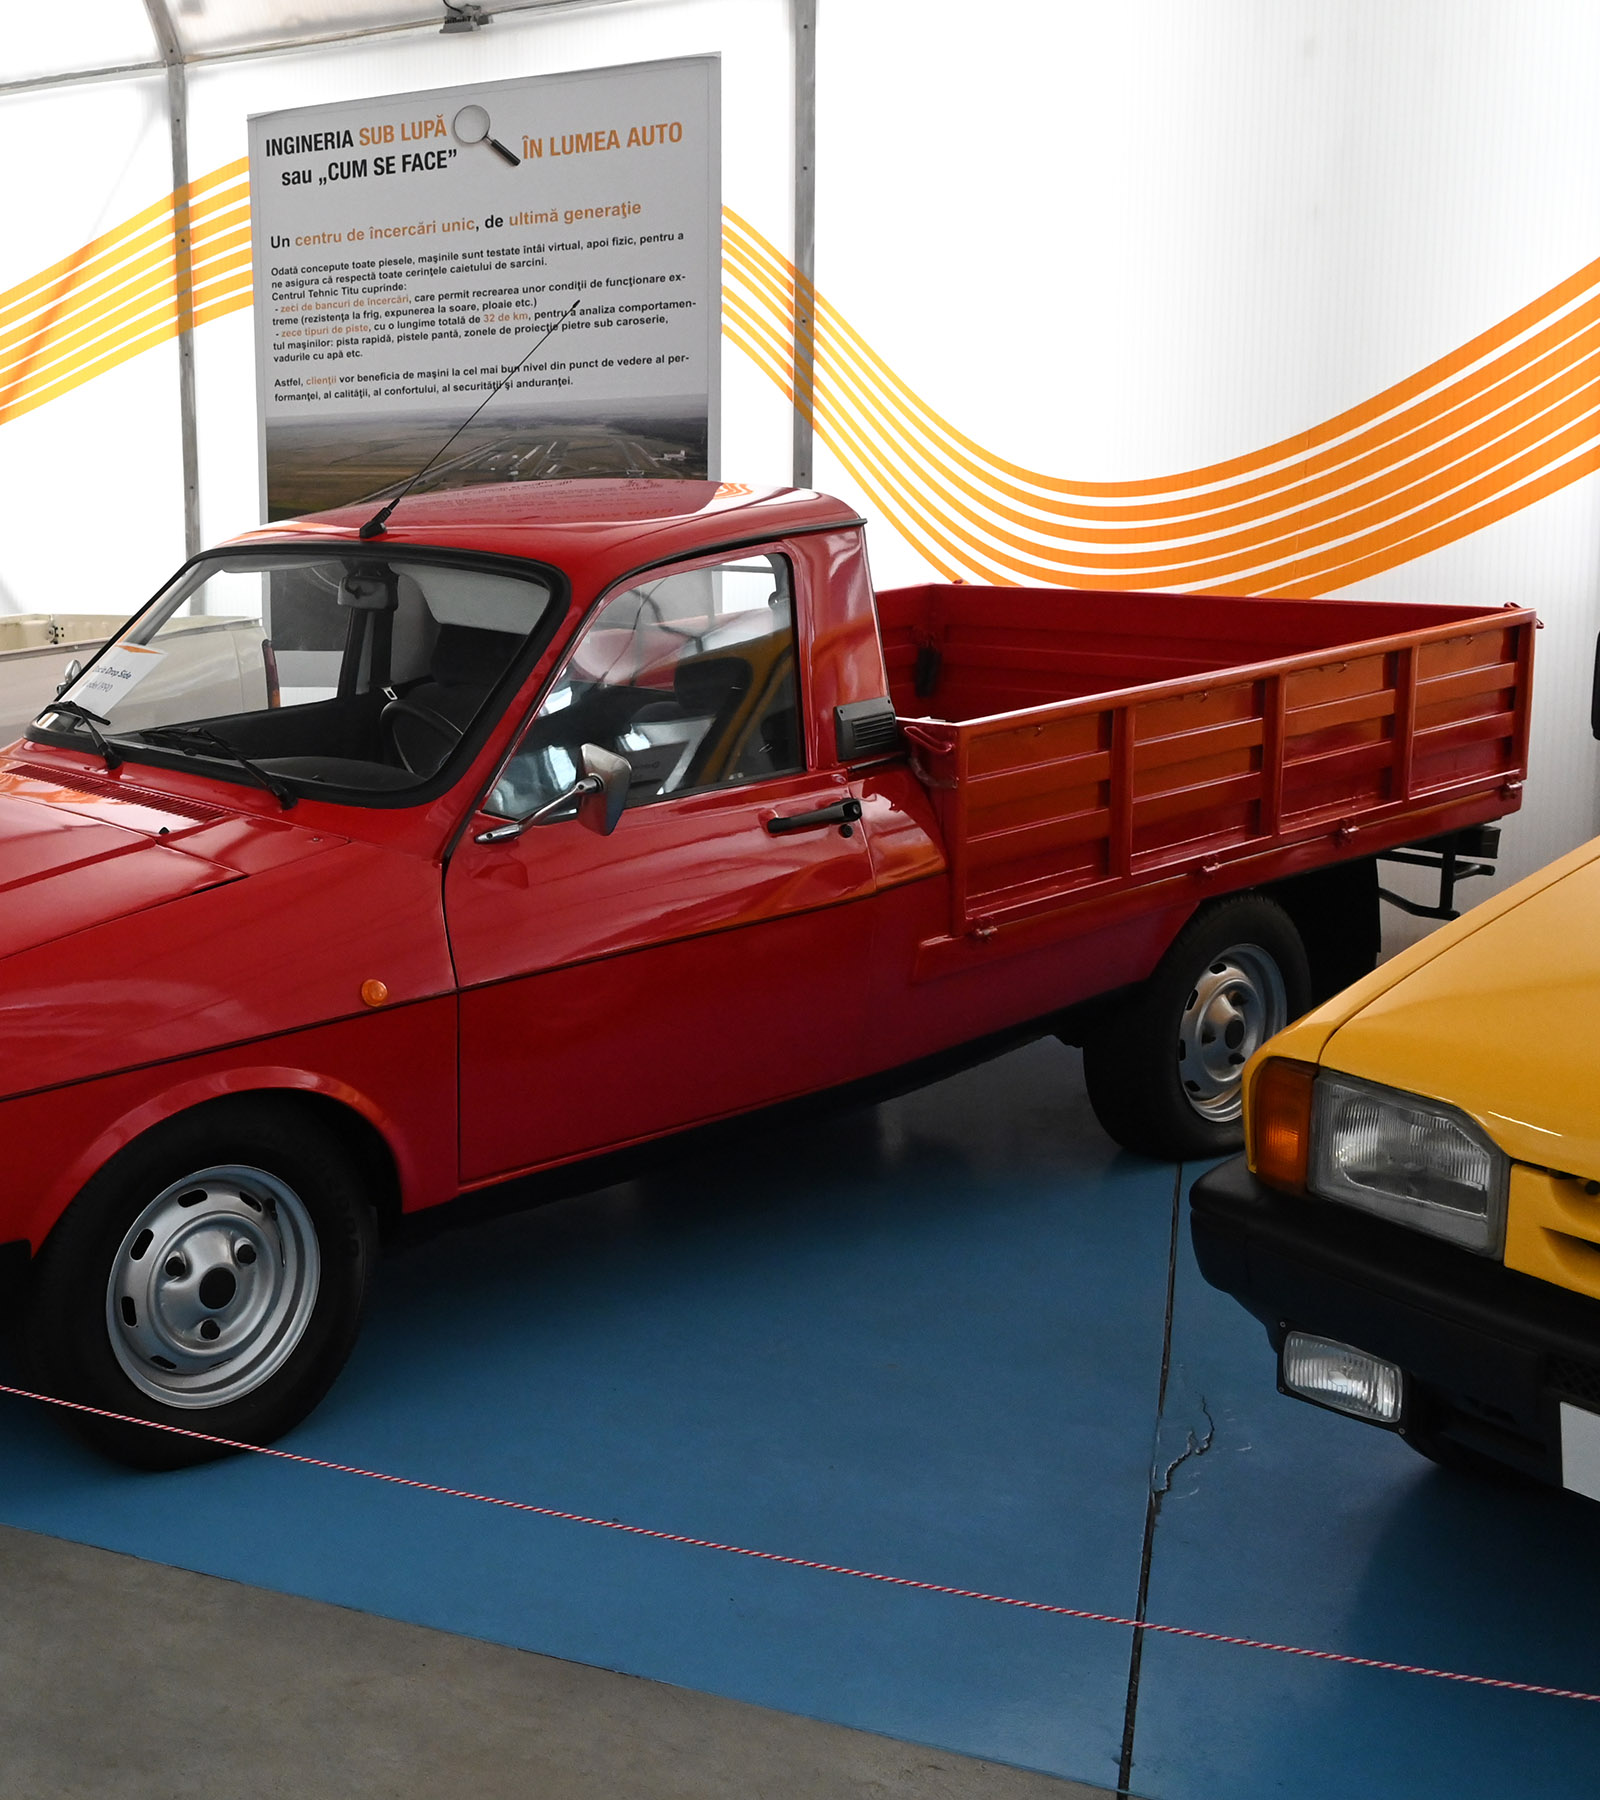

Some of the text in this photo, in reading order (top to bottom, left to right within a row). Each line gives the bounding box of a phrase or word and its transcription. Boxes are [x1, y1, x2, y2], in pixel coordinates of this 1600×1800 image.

[266, 114, 447, 157] INGINERIA SUB LUPĂ
[522, 121, 682, 159] ÎN LUMEA AUTO
[281, 148, 456, 186] sau „CUM SE FACE”
[270, 235, 290, 248] Un
[295, 232, 342, 246] centru
[346, 228, 364, 241] de
[369, 220, 436, 239] încercări
[442, 217, 479, 232] unic,
[484, 214, 503, 228] de
[509, 208, 558, 226] ultimă
[270, 266, 298, 276] Odată
[300, 262, 349, 273] concepute
[352, 260, 376, 269] toate
[462, 250, 484, 259] sunt
[486, 247, 520, 257] testate
[523, 243, 544, 254] întâi
[586, 237, 608, 250] apoi
[640, 233, 674, 246] pentru
[677, 232, 684, 240] a
[285, 278, 319, 288] asigura
[322, 275, 333, 284] că
[335, 271, 376, 284] respectă
[378, 270, 402, 279] toate
[450, 261, 492, 273] caietului
[494, 260, 507, 269] de
[272, 290, 305, 301] Centrul
[308, 288, 338, 298] Tehnic
[341, 286, 358, 295] Titu
[301, 303, 312, 311] de
[315, 299, 350, 310] bancuri
[353, 298, 364, 307] de
[414, 294, 435, 302] care
[438, 289, 469, 302] permit
[472, 287, 519, 297] recrearea
[522, 285, 546, 293] unor
[590, 279, 602, 288] de
[668, 274, 685, 282] ex-
[272, 317, 298, 325] treme
[352, 311, 360, 319] la
[384, 307, 434, 318] expunerea
[438, 304, 446, 313] la
[482, 299, 512, 311] ploaie
[304, 327, 328, 336] tipuri
[331, 326, 342, 334] de
[397, 319, 435, 330] lungime
[438, 315, 465, 326] totală
[468, 315, 480, 324] de
[483, 313, 494, 322] 32
[498, 313, 510, 321] de
[579, 305, 615, 316] analiza
[618, 300, 696, 313] comportamen-
[273, 341, 284, 350] tul
[336, 337, 359, 348] pista
[397, 331, 428, 343] pistele
[464, 326, 496, 337] zonele
[499, 325, 511, 334] de
[562, 321, 590, 332] pietre
[594, 318, 613, 328] sub
[273, 352, 310, 362] vadurile
[326, 350, 343, 360] apă
[357, 371, 400, 382] beneficia
[402, 371, 414, 379] de
[452, 368, 460, 376] la
[463, 366, 477, 375] cel
[480, 365, 498, 374] mai
[523, 362, 547, 372] nivel
[550, 361, 566, 370] din
[569, 359, 598, 371] punct
[601, 358, 614, 367] de
[617, 356, 652, 366] vedere
[655, 354, 664, 364] al
[668, 355, 689, 365] per-
[323, 390, 331, 399] al
[373, 387, 381, 396] al
[442, 383, 450, 392] al
